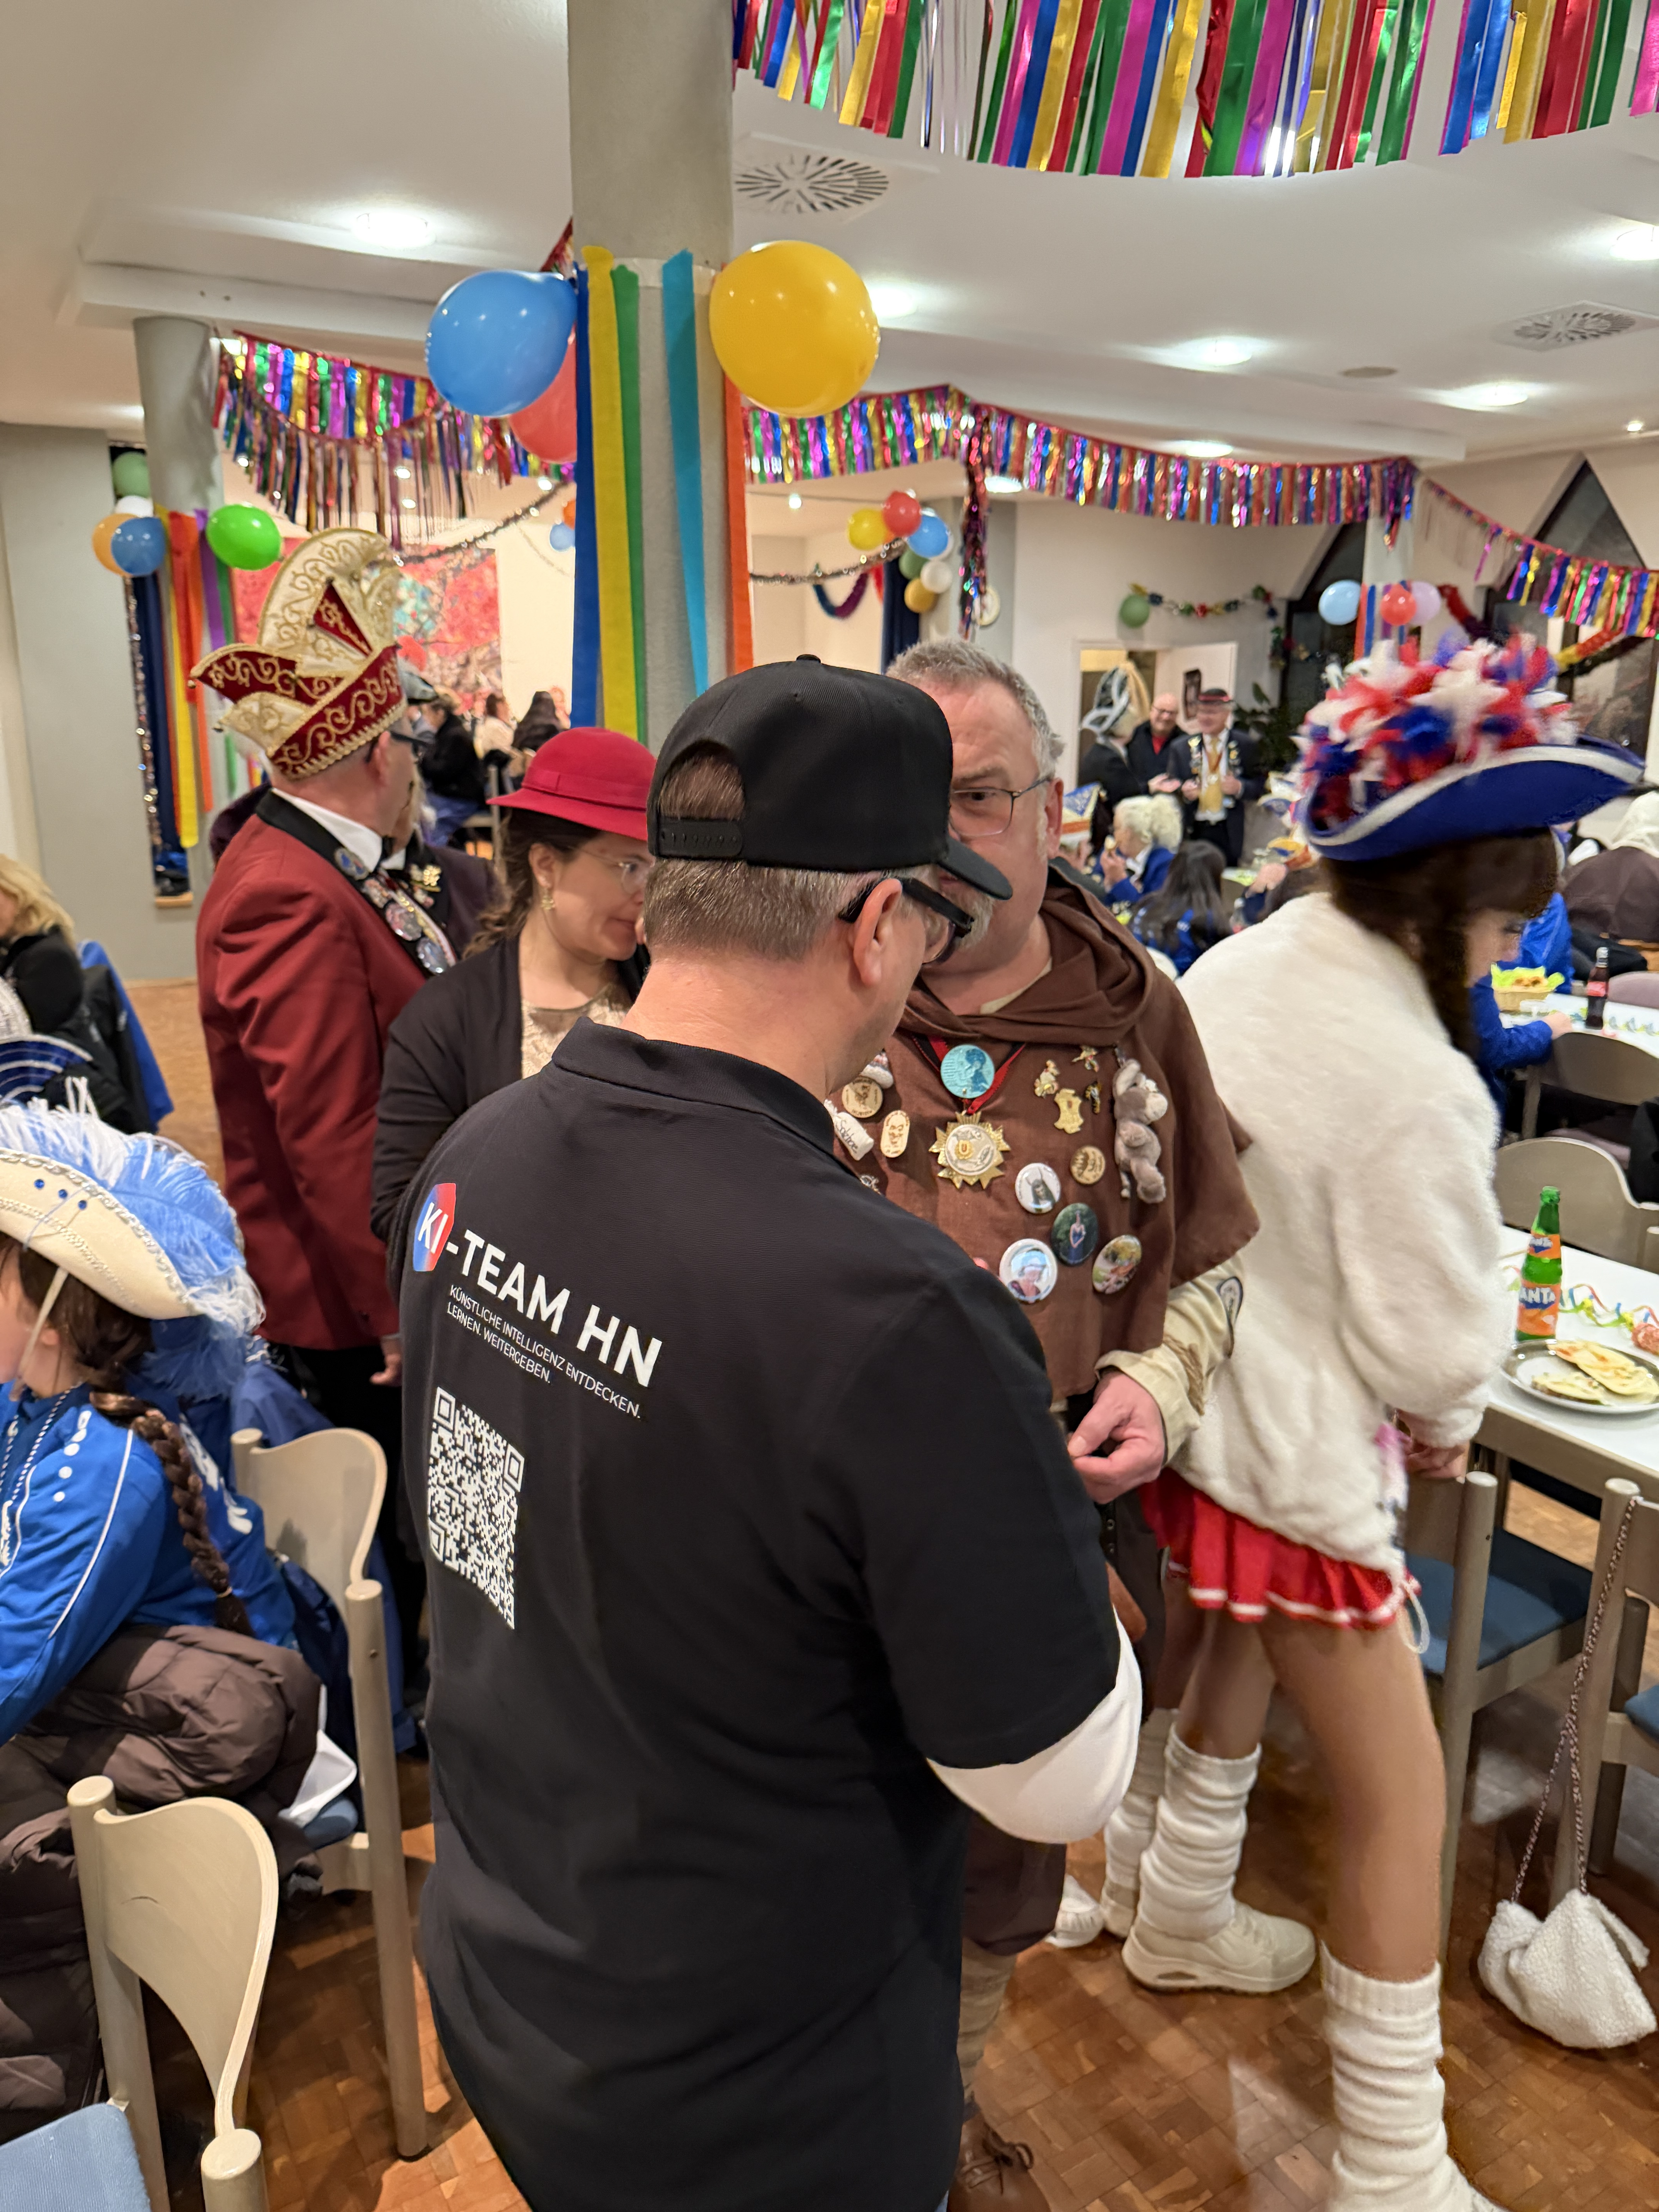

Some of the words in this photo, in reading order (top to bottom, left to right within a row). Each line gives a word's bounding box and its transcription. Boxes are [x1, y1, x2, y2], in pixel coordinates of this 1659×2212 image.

[1519, 1287, 1556, 1304] ANTA
[447, 1302, 481, 1336] LERNEN.
[484, 1330, 551, 1383] WEITERGEBEN.
[450, 1285, 501, 1329] KÜNSTLICHE
[503, 1323, 564, 1370] INTELLIGENZ
[566, 1363, 641, 1418] ENTDECKEN.
[577, 1305, 662, 1387] HN
